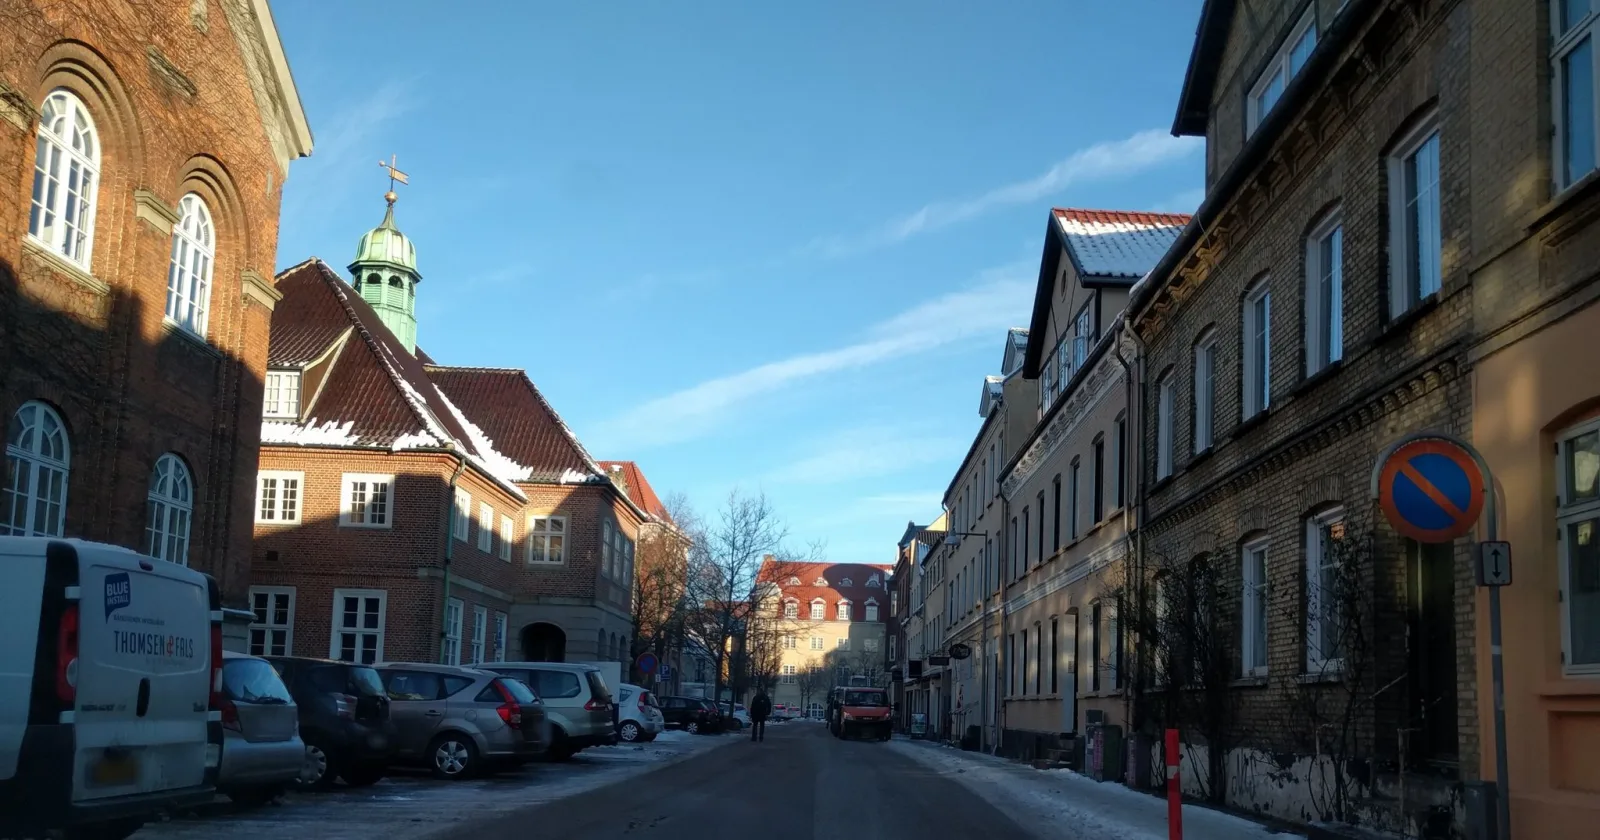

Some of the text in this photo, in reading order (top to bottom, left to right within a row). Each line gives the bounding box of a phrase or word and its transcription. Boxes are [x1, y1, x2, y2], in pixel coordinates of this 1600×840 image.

[107, 581, 128, 596] BLUE
[107, 594, 128, 605] INSTALL
[114, 630, 165, 656] THOMSEN
[175, 636, 194, 658] FALS
